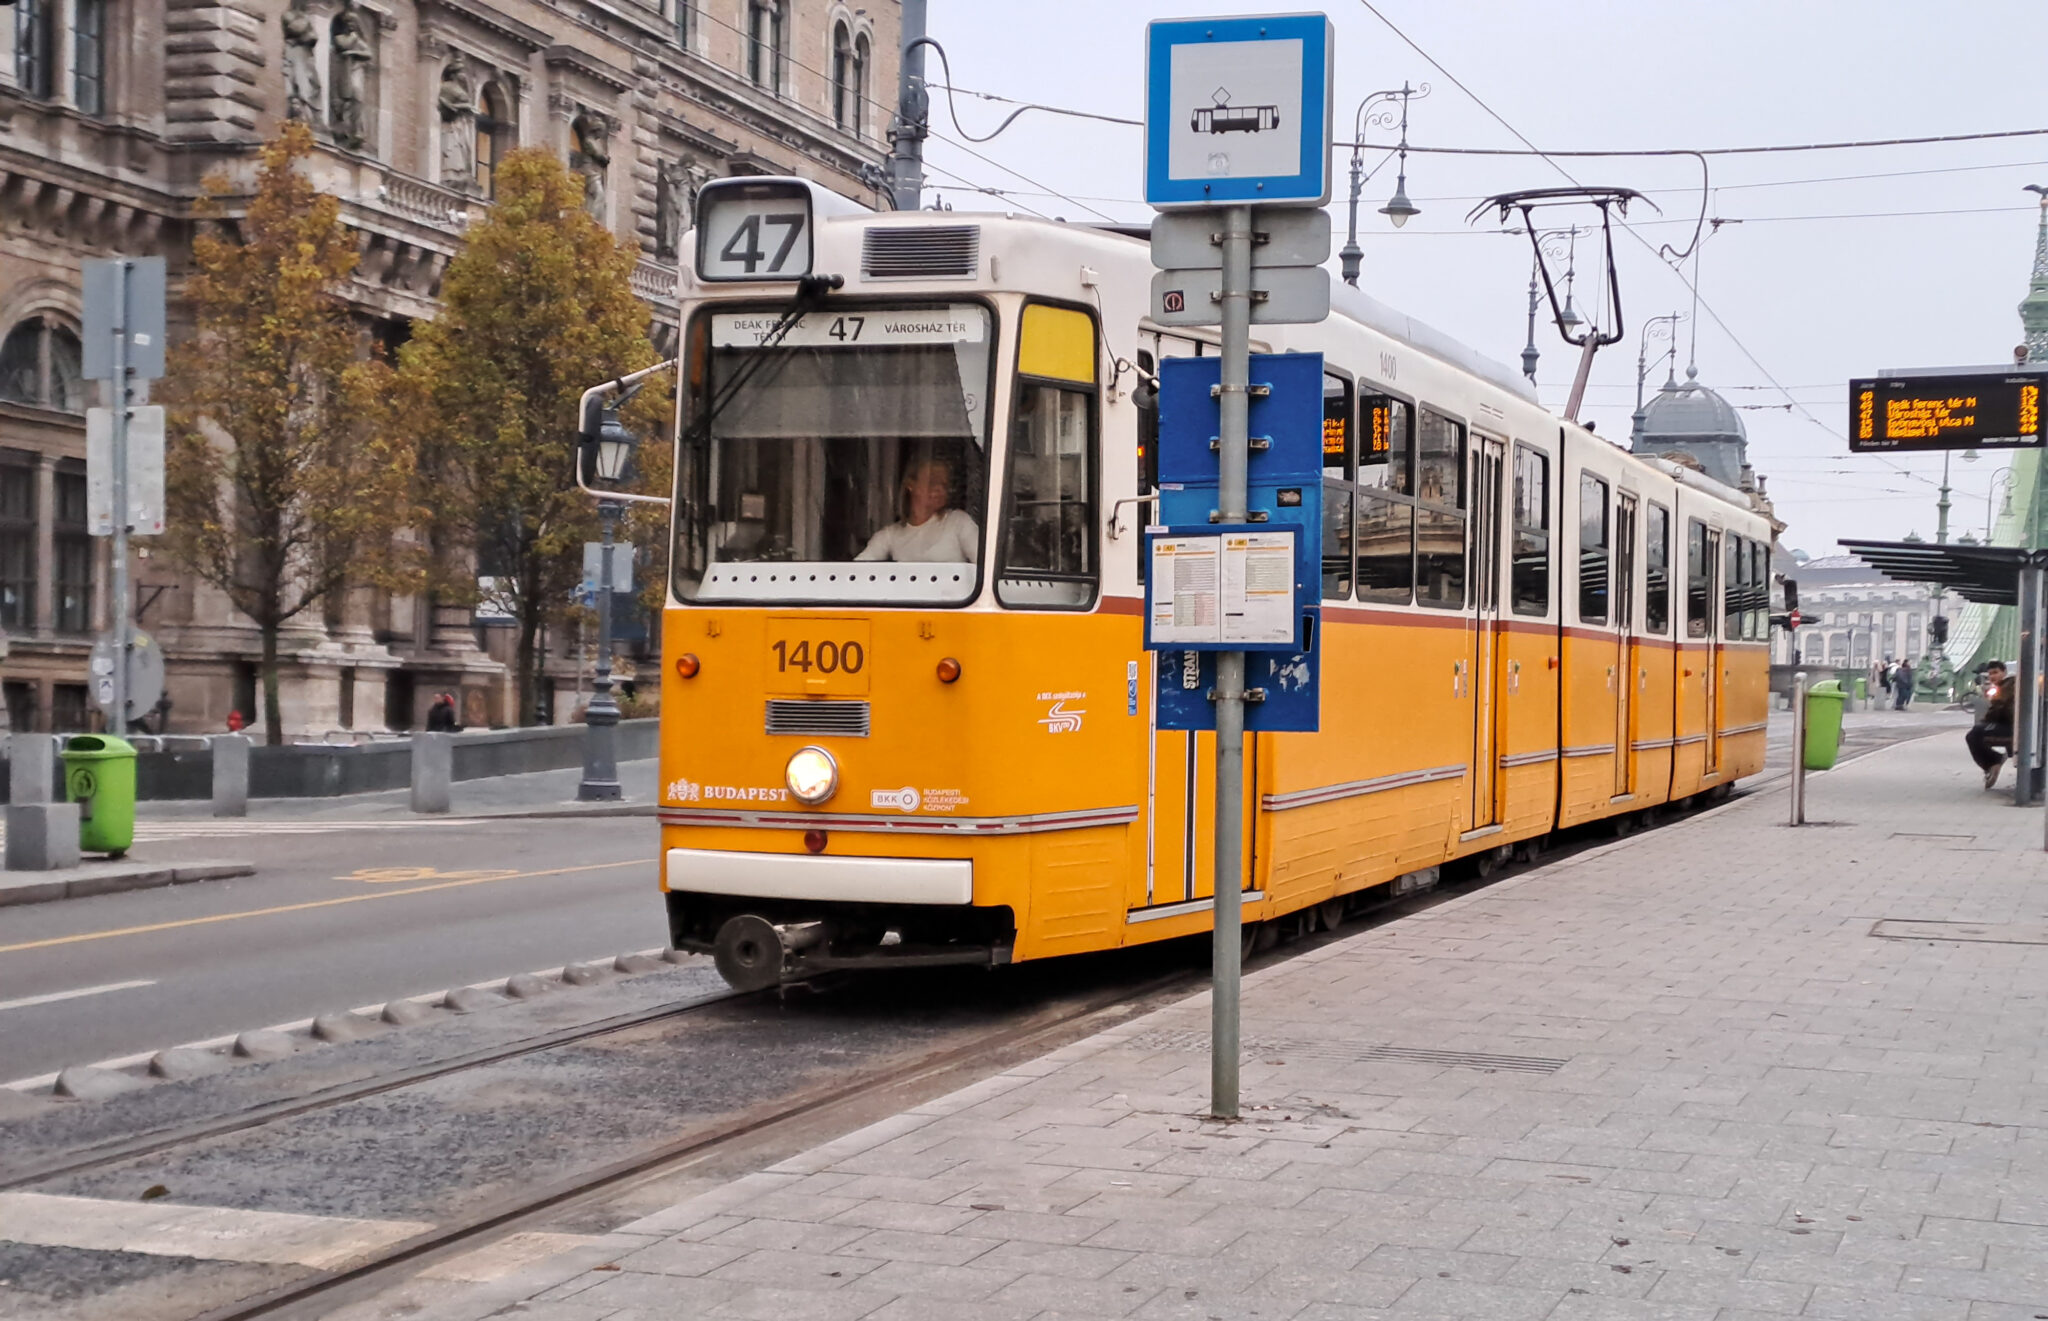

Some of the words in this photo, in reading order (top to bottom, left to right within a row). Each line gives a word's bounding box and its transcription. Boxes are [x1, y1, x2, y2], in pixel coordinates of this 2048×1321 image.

[720, 213, 805, 273] 47
[828, 316, 865, 341] 47
[884, 321, 943, 333] VÁROSHÁZ
[946, 321, 966, 332] TÉR
[1380, 351, 1397, 381] 1400
[772, 640, 864, 674] 1400
[704, 786, 789, 801] BUDAPEST
[877, 795, 897, 803] BKK
